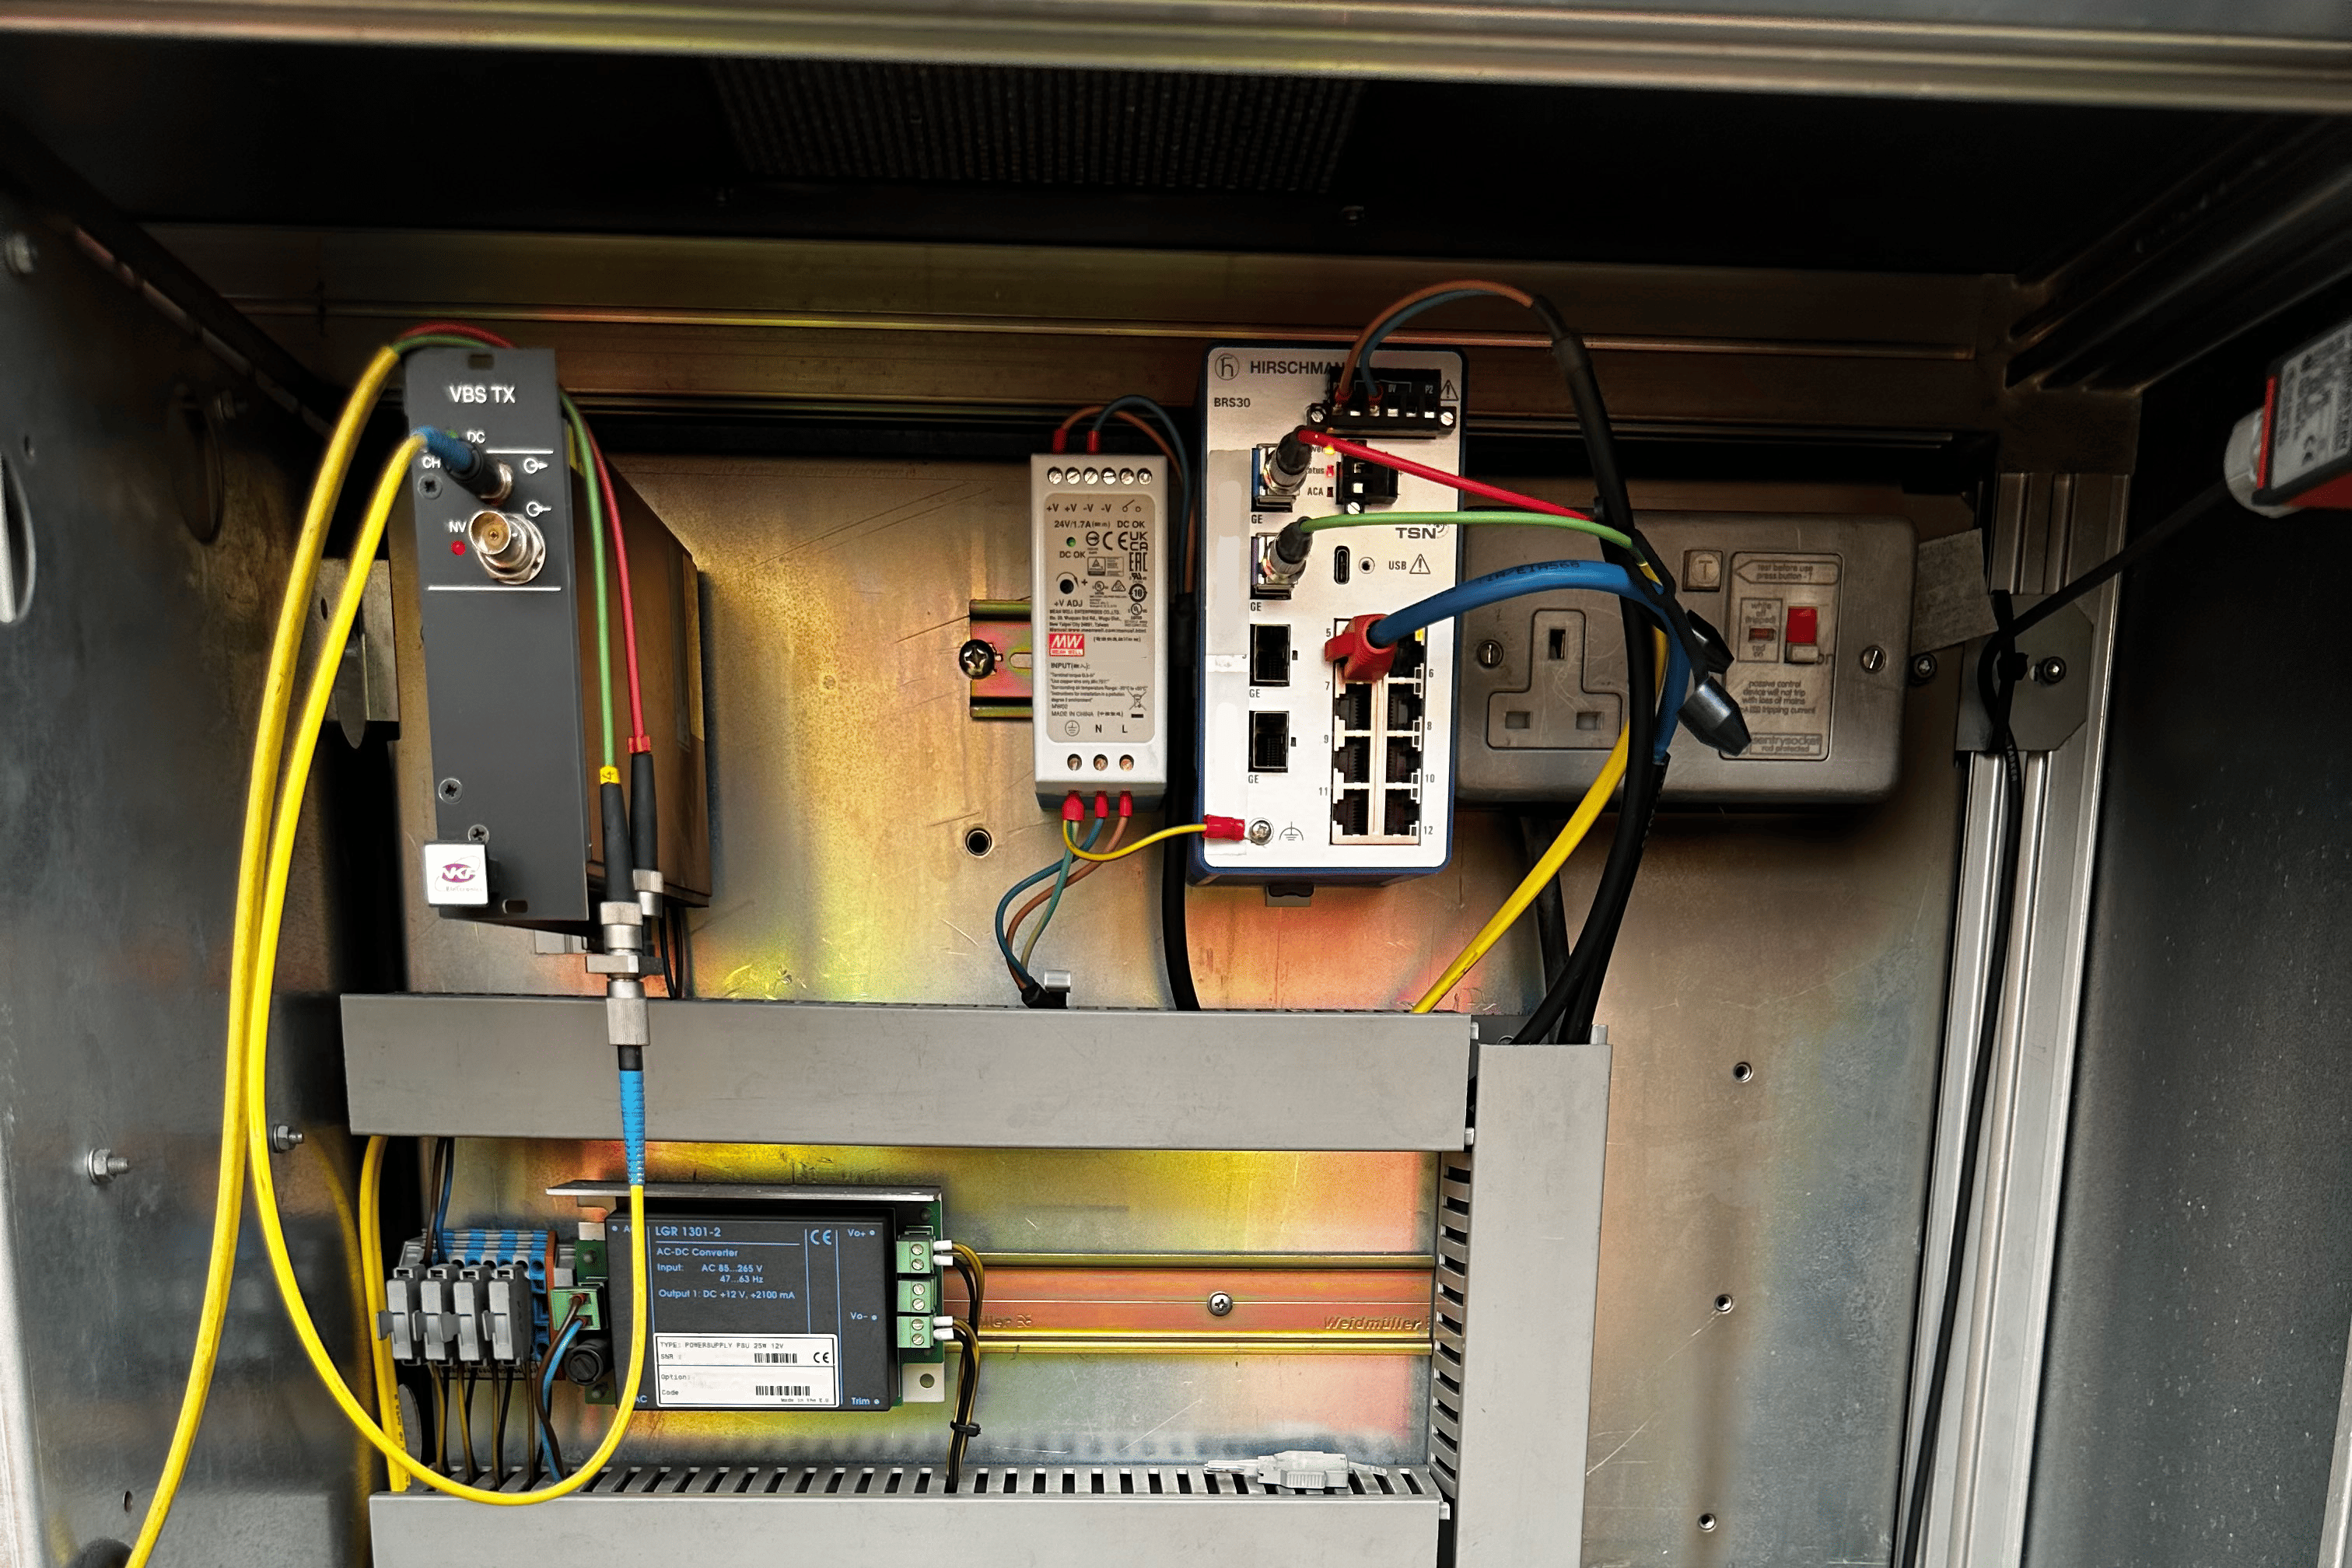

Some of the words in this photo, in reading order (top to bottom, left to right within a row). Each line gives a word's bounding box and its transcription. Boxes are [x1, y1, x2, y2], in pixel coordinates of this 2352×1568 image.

[1425, 385, 1433, 394] P2
[450, 387, 487, 404] VBS
[491, 387, 516, 404] TX
[1213, 397, 1251, 408] BRS30
[467, 432, 485, 443] DC
[422, 457, 441, 469] CH
[1307, 487, 1324, 495] ACA
[1046, 503, 1059, 512] +V
[1065, 503, 1077, 512] +V
[1101, 504, 1111, 513] -V
[1251, 514, 1263, 524] GE
[449, 521, 467, 533] NV
[1130, 531, 1148, 541] UK
[1395, 527, 1436, 539] TSN
[1103, 531, 1128, 551] CE
[1130, 541, 1148, 551] CA
[1388, 561, 1406, 570] USB
[1698, 560, 1713, 579] T
[1756, 572, 1776, 581] press
[1250, 602, 1262, 611] GE
[1325, 628, 1331, 637] 5
[1051, 635, 1083, 648] MW
[1429, 669, 1433, 677] 6
[1325, 681, 1330, 691] 7
[1249, 689, 1261, 698] GE
[1095, 724, 1102, 733] N
[1122, 724, 1128, 733] L
[1427, 722, 1432, 730] 8
[1324, 734, 1328, 744] 9
[1248, 775, 1259, 784] GE
[1425, 774, 1435, 783] 10
[1319, 787, 1328, 796] 11
[1423, 826, 1433, 835] 12
[655, 1227, 678, 1236] LGR
[682, 1227, 721, 1237] 1301-2
[810, 1229, 832, 1245] CE
[656, 1248, 690, 1256] AC-DC
[691, 1248, 738, 1256] Converter
[657, 1263, 684, 1272] Input:
[658, 1290, 691, 1298] Output
[703, 1290, 717, 1298] DC
[850, 1311, 868, 1320] Vo-
[1324, 1315, 1422, 1330] Weidmüller
[813, 1352, 830, 1363] CE
